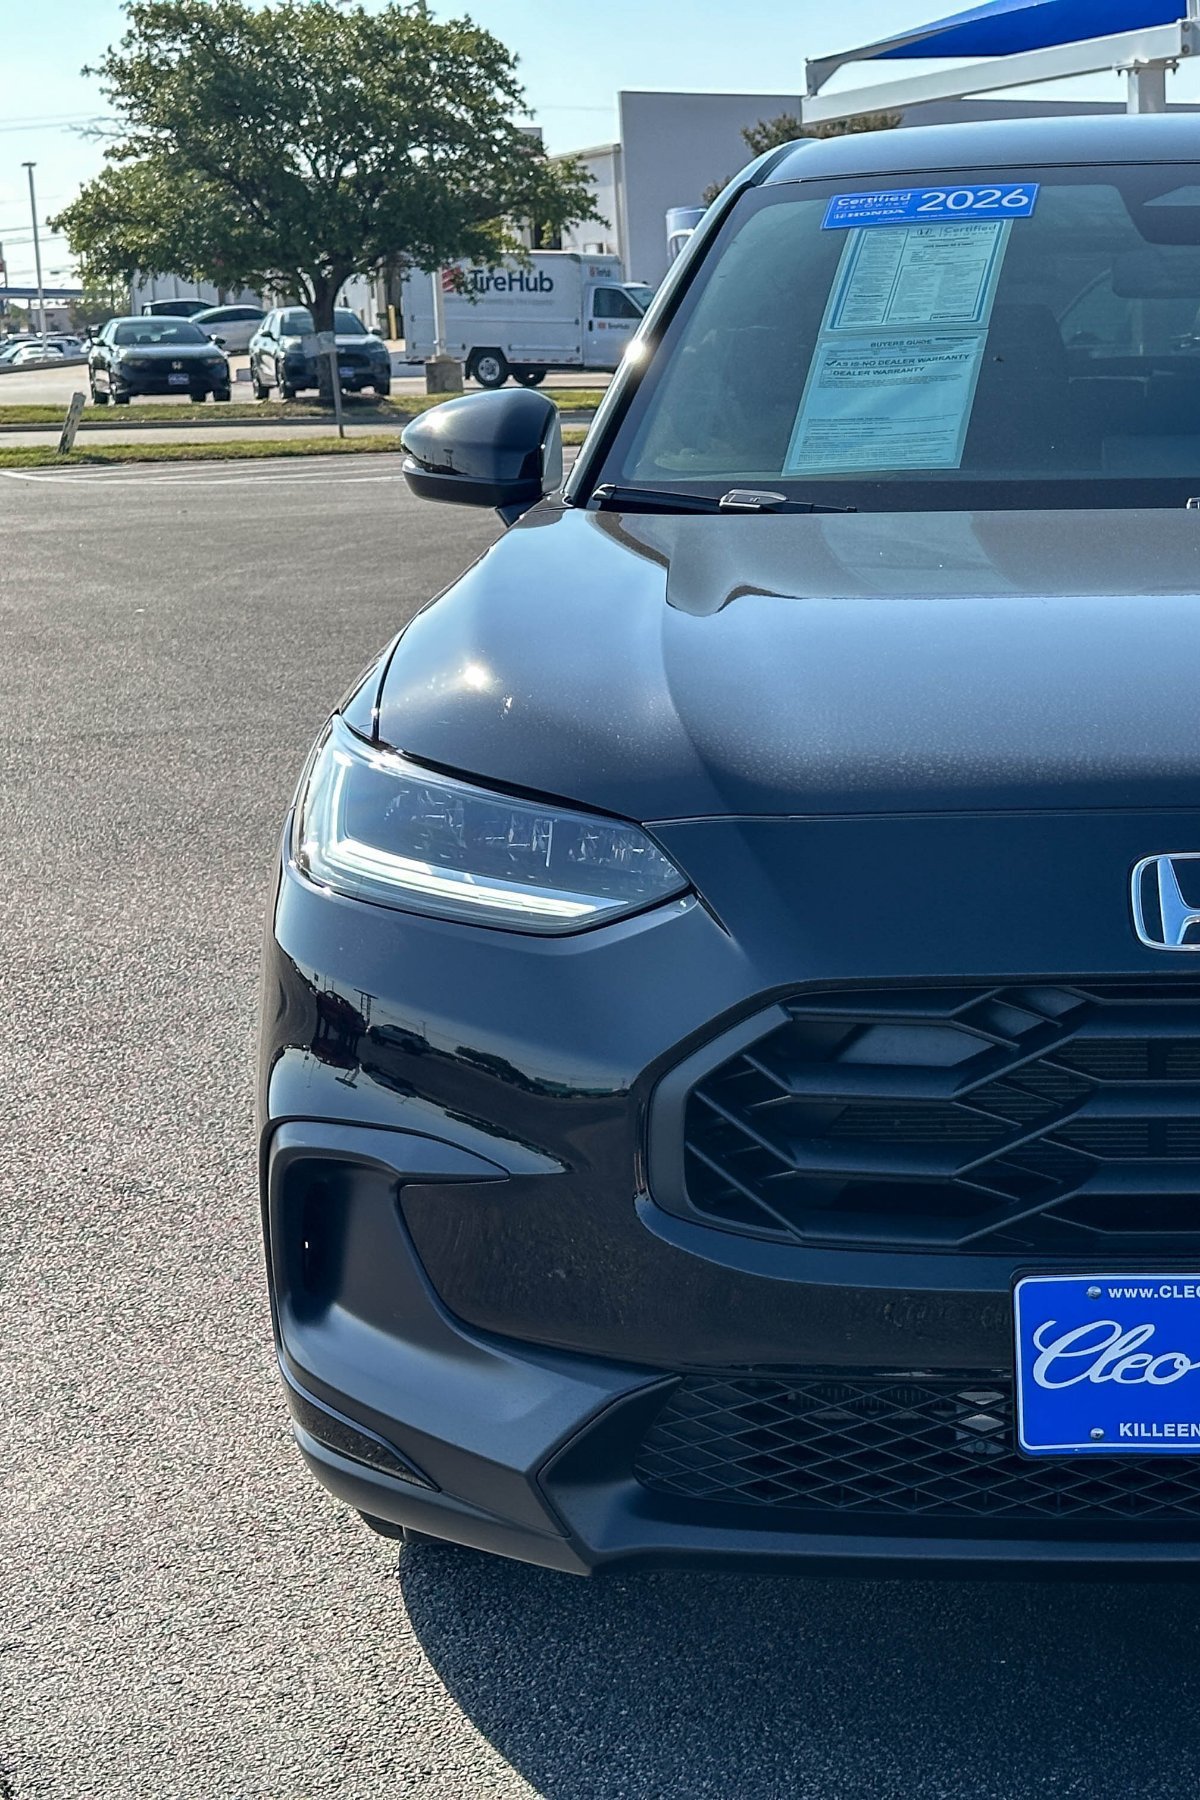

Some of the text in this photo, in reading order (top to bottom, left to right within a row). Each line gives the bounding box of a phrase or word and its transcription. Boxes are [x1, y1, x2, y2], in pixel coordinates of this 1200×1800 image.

[838, 193, 912, 207] Certified
[916, 188, 1030, 212] 2026
[848, 209, 906, 218] HONDA
[944, 224, 997, 234] Certified
[468, 269, 554, 292] TireHub
[870, 339, 905, 347] BUYERS
[906, 338, 933, 346] GUIDE
[878, 358, 915, 366] DEALER
[917, 354, 970, 363] WARRANTY
[873, 366, 926, 375] WARRANTY
